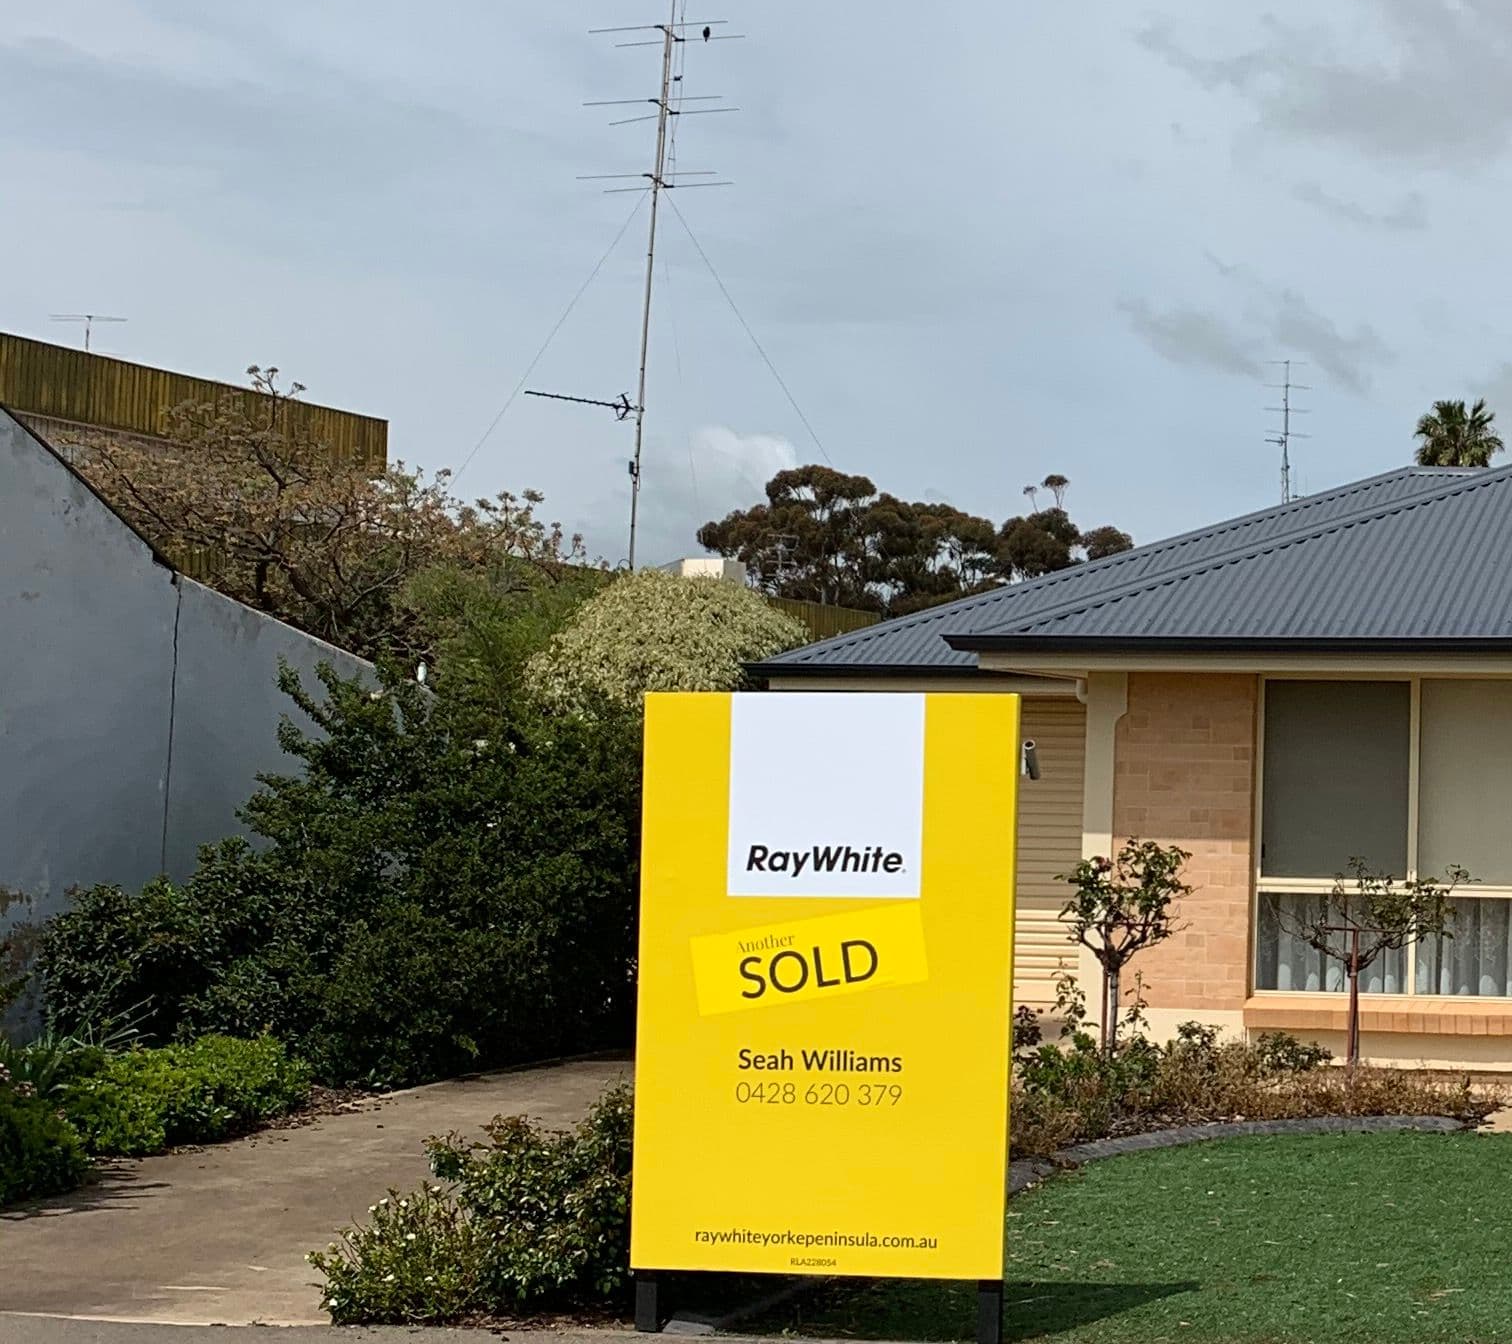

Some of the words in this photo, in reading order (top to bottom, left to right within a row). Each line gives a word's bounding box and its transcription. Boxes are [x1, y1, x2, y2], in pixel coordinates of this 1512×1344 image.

[736, 934, 795, 953] Another
[739, 939, 878, 999] SOLD
[738, 1049, 793, 1071] Seah
[802, 1050, 902, 1072] Williams
[736, 1082, 796, 1104] 0428
[804, 1083, 850, 1105] 620
[857, 1084, 902, 1106] 379
[695, 1229, 937, 1249] raywhiteyorkepeninsula.com.au
